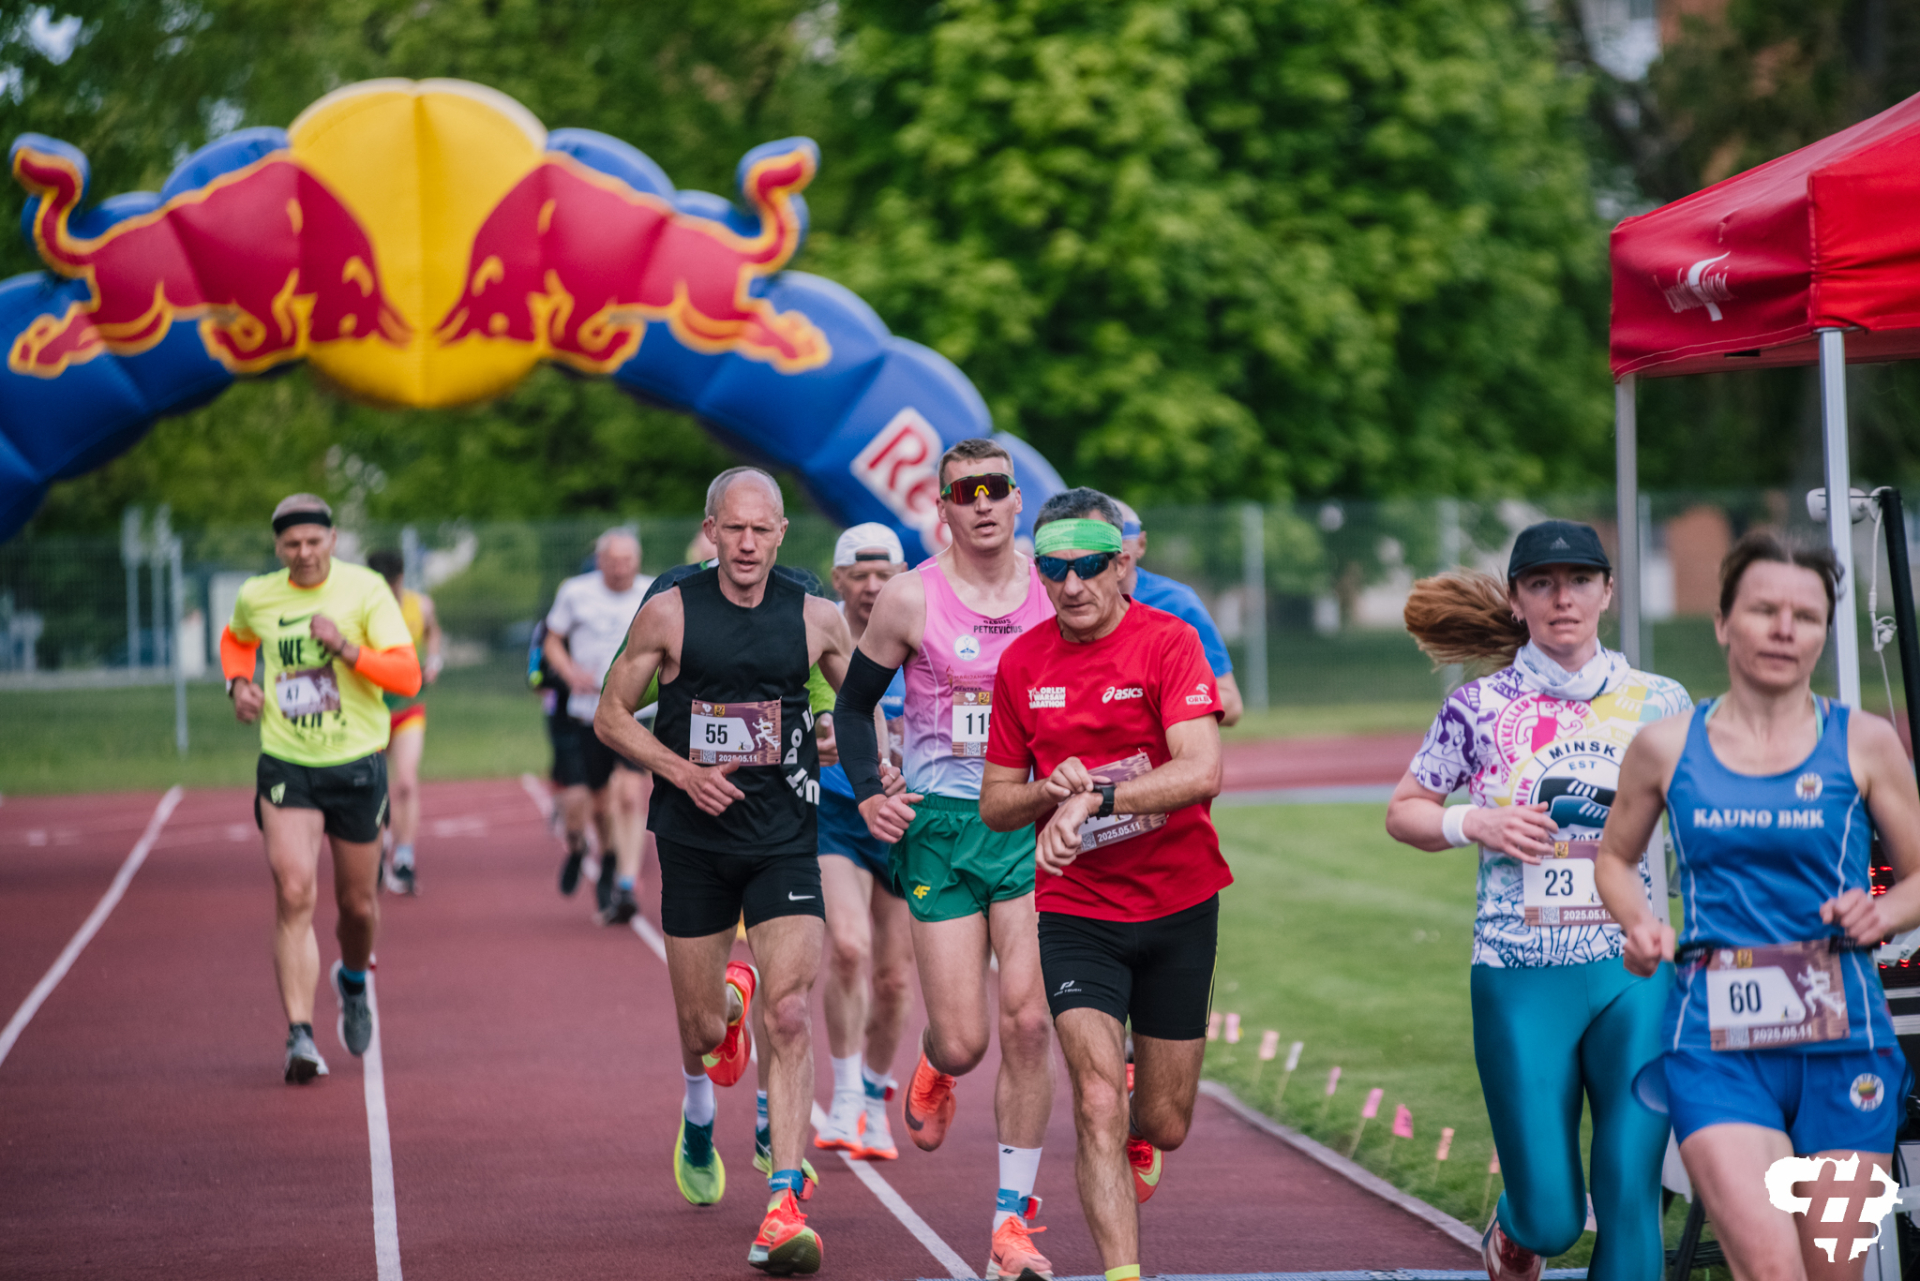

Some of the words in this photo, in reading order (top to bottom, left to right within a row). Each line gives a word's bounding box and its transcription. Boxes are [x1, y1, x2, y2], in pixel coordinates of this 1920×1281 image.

[1034, 693, 1066, 701] WARSAW
[1040, 686, 1066, 694] ORLEN
[706, 723, 728, 745] 55
[966, 713, 991, 735] 11
[1501, 700, 1530, 764] MIKKELLER
[719, 754, 758, 763] 20205.11
[1549, 741, 1617, 760] MINSK
[1568, 760, 1597, 771] EST
[1693, 808, 1773, 829] KAUNO
[1777, 809, 1825, 830] BMK
[1097, 821, 1141, 843] 2025.05.11
[913, 885, 931, 900] 4F
[1544, 868, 1574, 897] 23
[1730, 980, 1762, 1014] 60
[1753, 1023, 1812, 1044] 2025.05.11
